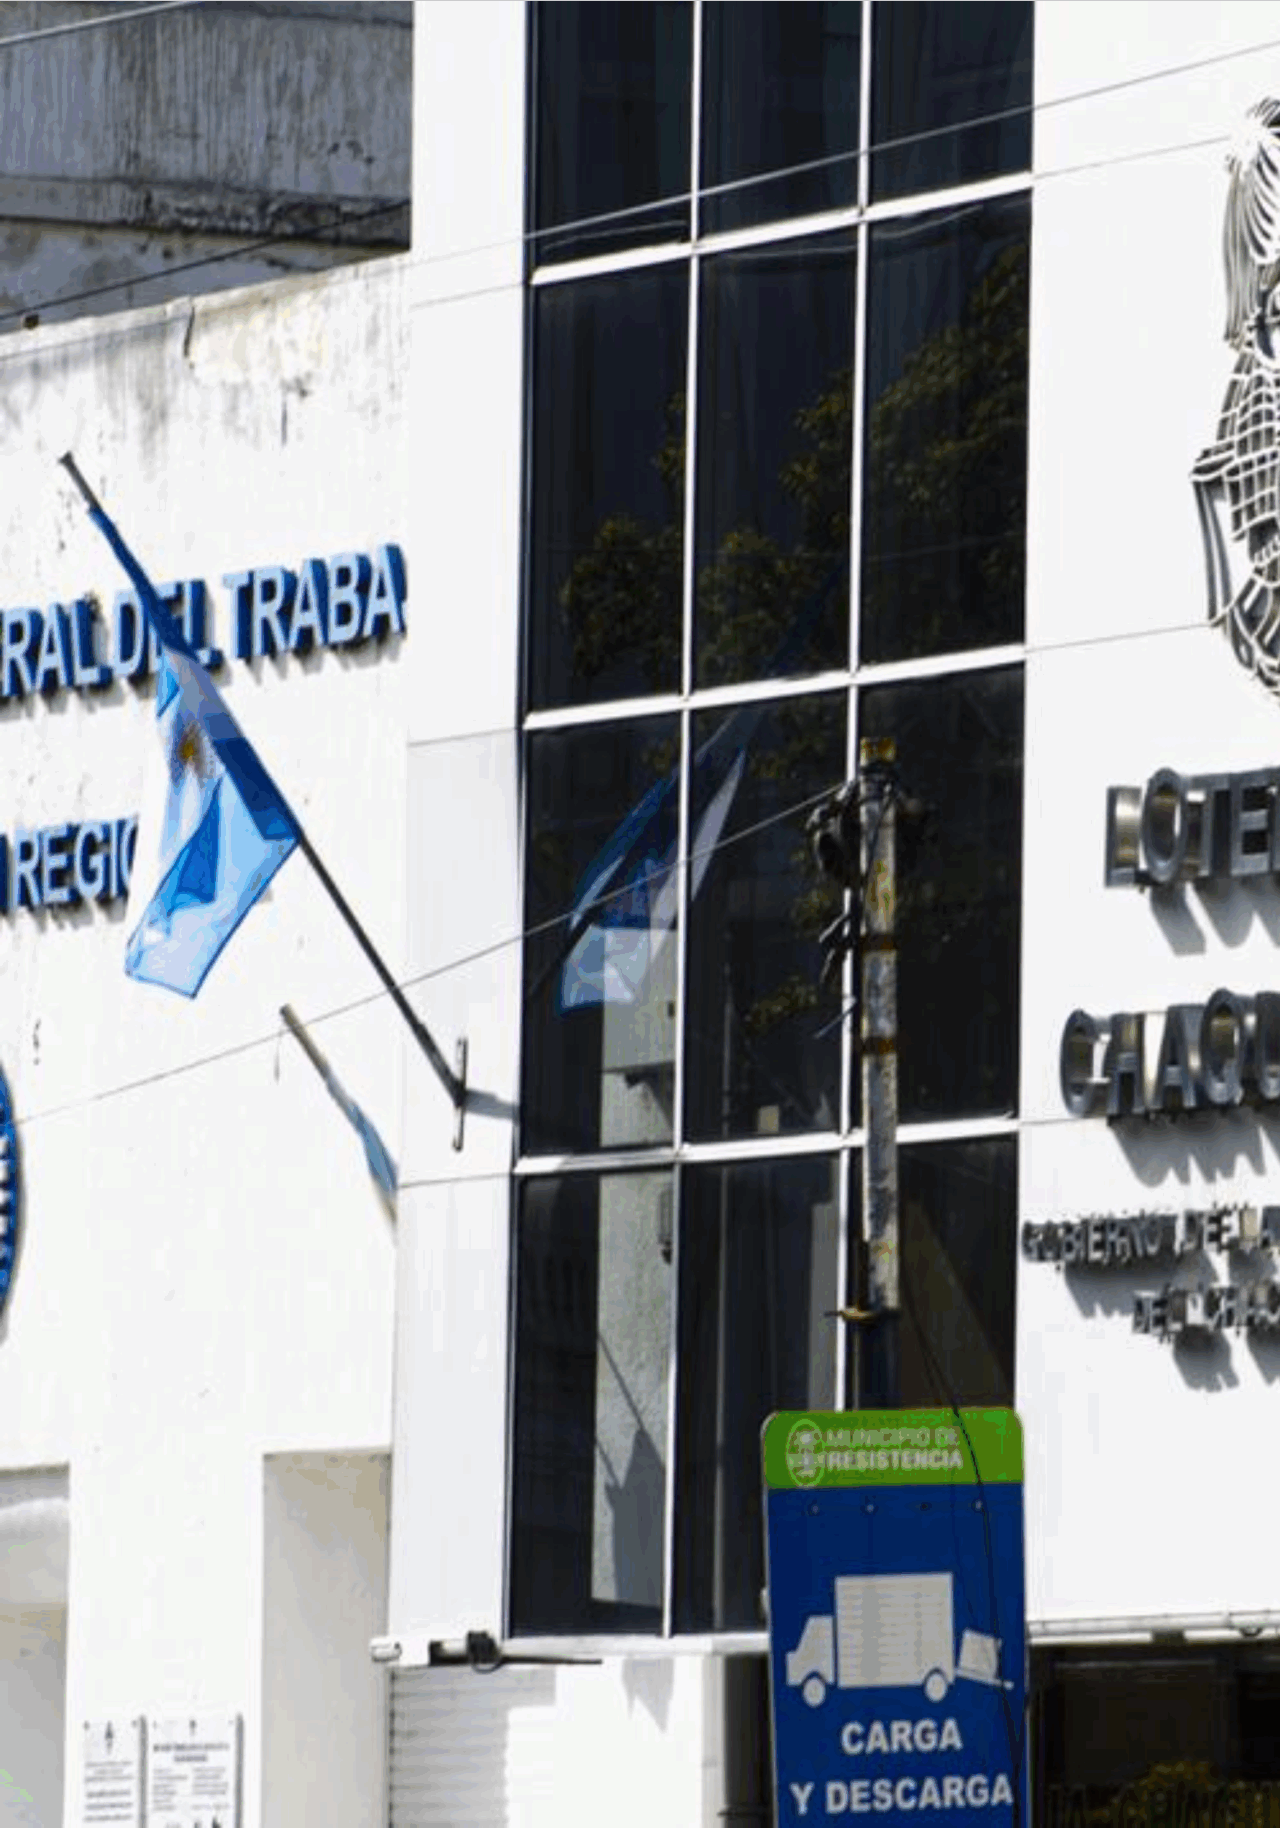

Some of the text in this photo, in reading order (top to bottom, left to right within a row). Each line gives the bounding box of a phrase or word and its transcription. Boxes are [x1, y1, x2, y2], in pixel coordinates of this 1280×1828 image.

[222, 545, 407, 660] TRABA
[825, 1427, 931, 1447] MUNICIPIO
[826, 1449, 964, 1472] RESISTENCIA
[841, 1717, 964, 1755] CARGA
[789, 1782, 814, 1816] Y
[825, 1772, 1014, 1814] DESCARGA
